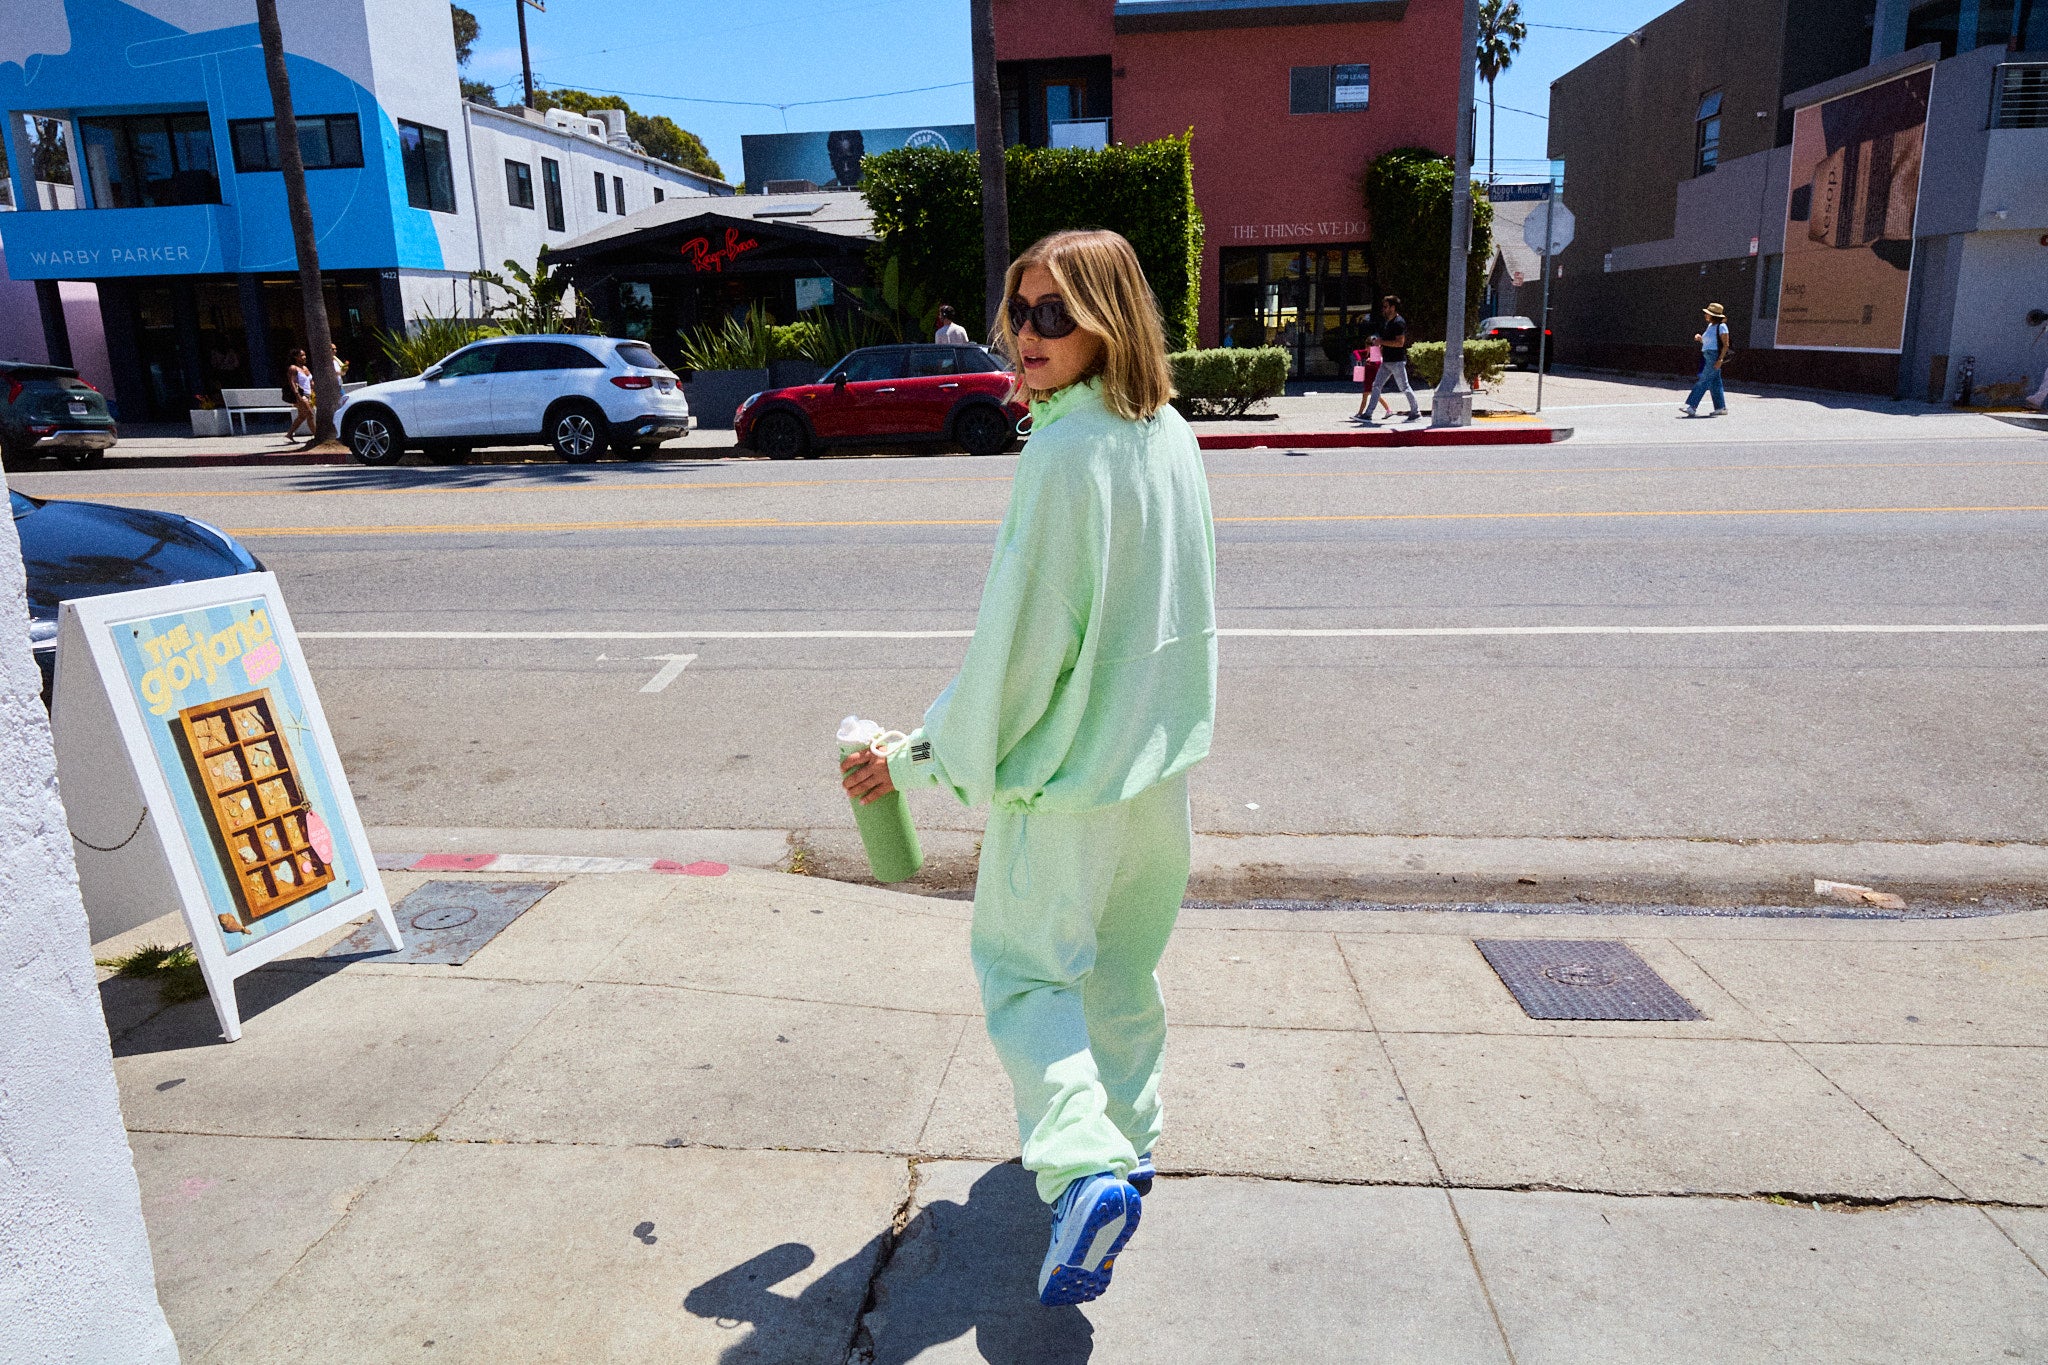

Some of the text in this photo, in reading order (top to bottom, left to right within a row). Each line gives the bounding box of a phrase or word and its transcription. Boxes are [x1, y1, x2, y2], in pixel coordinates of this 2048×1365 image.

[1492, 185, 1544, 196] Abbot Kinney
[1231, 221, 1366, 239] THE THINGS WE DO
[30, 246, 190, 265] WARBY PARKER
[681, 226, 758, 272] Ray-Ban
[144, 623, 192, 664] THE
[141, 608, 273, 716] gorjana
